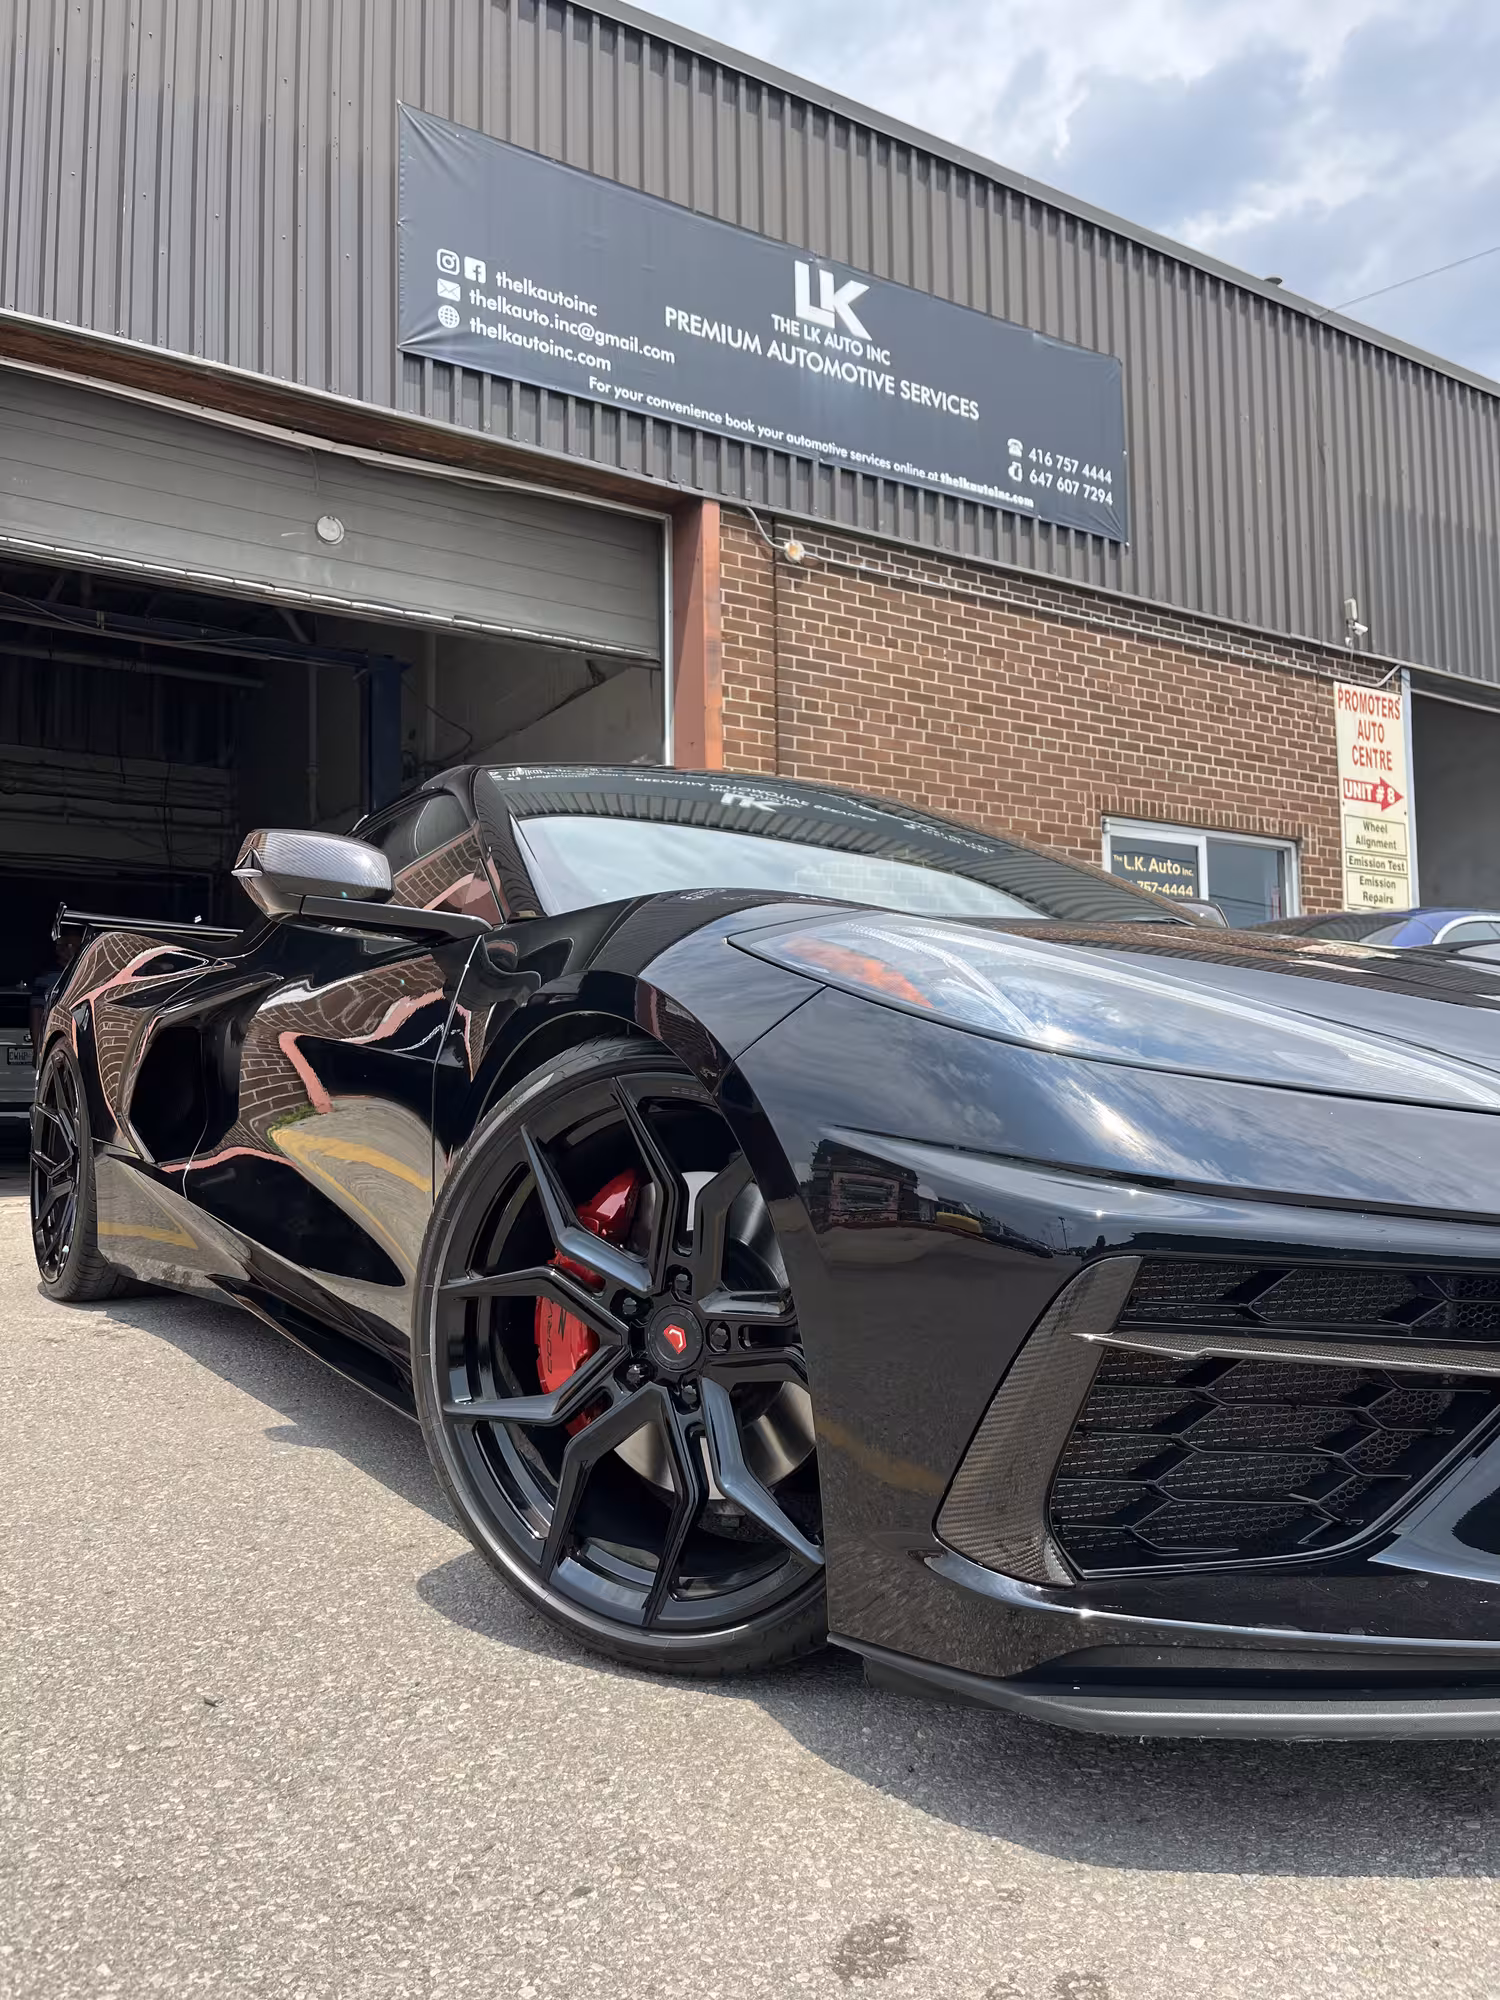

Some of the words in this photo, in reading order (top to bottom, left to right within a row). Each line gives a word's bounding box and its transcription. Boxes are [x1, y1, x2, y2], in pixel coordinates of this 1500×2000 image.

[496, 272, 598, 316] thelkautoinc
[794, 260, 872, 341] LK
[469, 289, 675, 364] thelkauto.inc@gmail.com
[771, 314, 800, 337] THE
[804, 324, 821, 345] LK
[824, 334, 863, 357] AUTO
[866, 344, 891, 366] INC
[470, 317, 611, 371] thelkautoinc.com
[665, 306, 762, 356] PREMIUM
[767, 340, 895, 395] AUTOMOTIVE
[900, 380, 980, 421] SERVICES
[589, 376, 611, 394] For
[614, 386, 643, 402] your
[646, 394, 722, 424] convenience
[726, 413, 755, 433] book
[758, 424, 784, 441] your
[786, 434, 848, 458] automotive
[850, 448, 891, 470] services
[894, 461, 925, 480] online
[928, 471, 939, 482] at
[940, 473, 1034, 508] thelkautoinc.com
[1028, 447, 1053, 468] 416
[1056, 454, 1079, 475] 757
[1082, 463, 1113, 485] 4444
[1030, 468, 1054, 489] 647
[1056, 476, 1080, 497] 607
[1082, 483, 1114, 506] 7294
[1338, 688, 1401, 720] PROMOTERS
[1358, 719, 1385, 743] AUTO
[1352, 744, 1393, 771] CENTRE
[1344, 780, 1373, 801] UNIT
[1356, 835, 1397, 850] Alignment
[1363, 820, 1387, 833] Wheel
[1113, 854, 1123, 862] The
[1124, 854, 1147, 872] L.K.
[1148, 858, 1181, 875] Auto
[1182, 868, 1194, 877] Inc.
[1349, 856, 1385, 870] Emission
[1388, 860, 1405, 872] Test
[1360, 876, 1396, 889] Emission
[1363, 892, 1394, 904] Repairs
